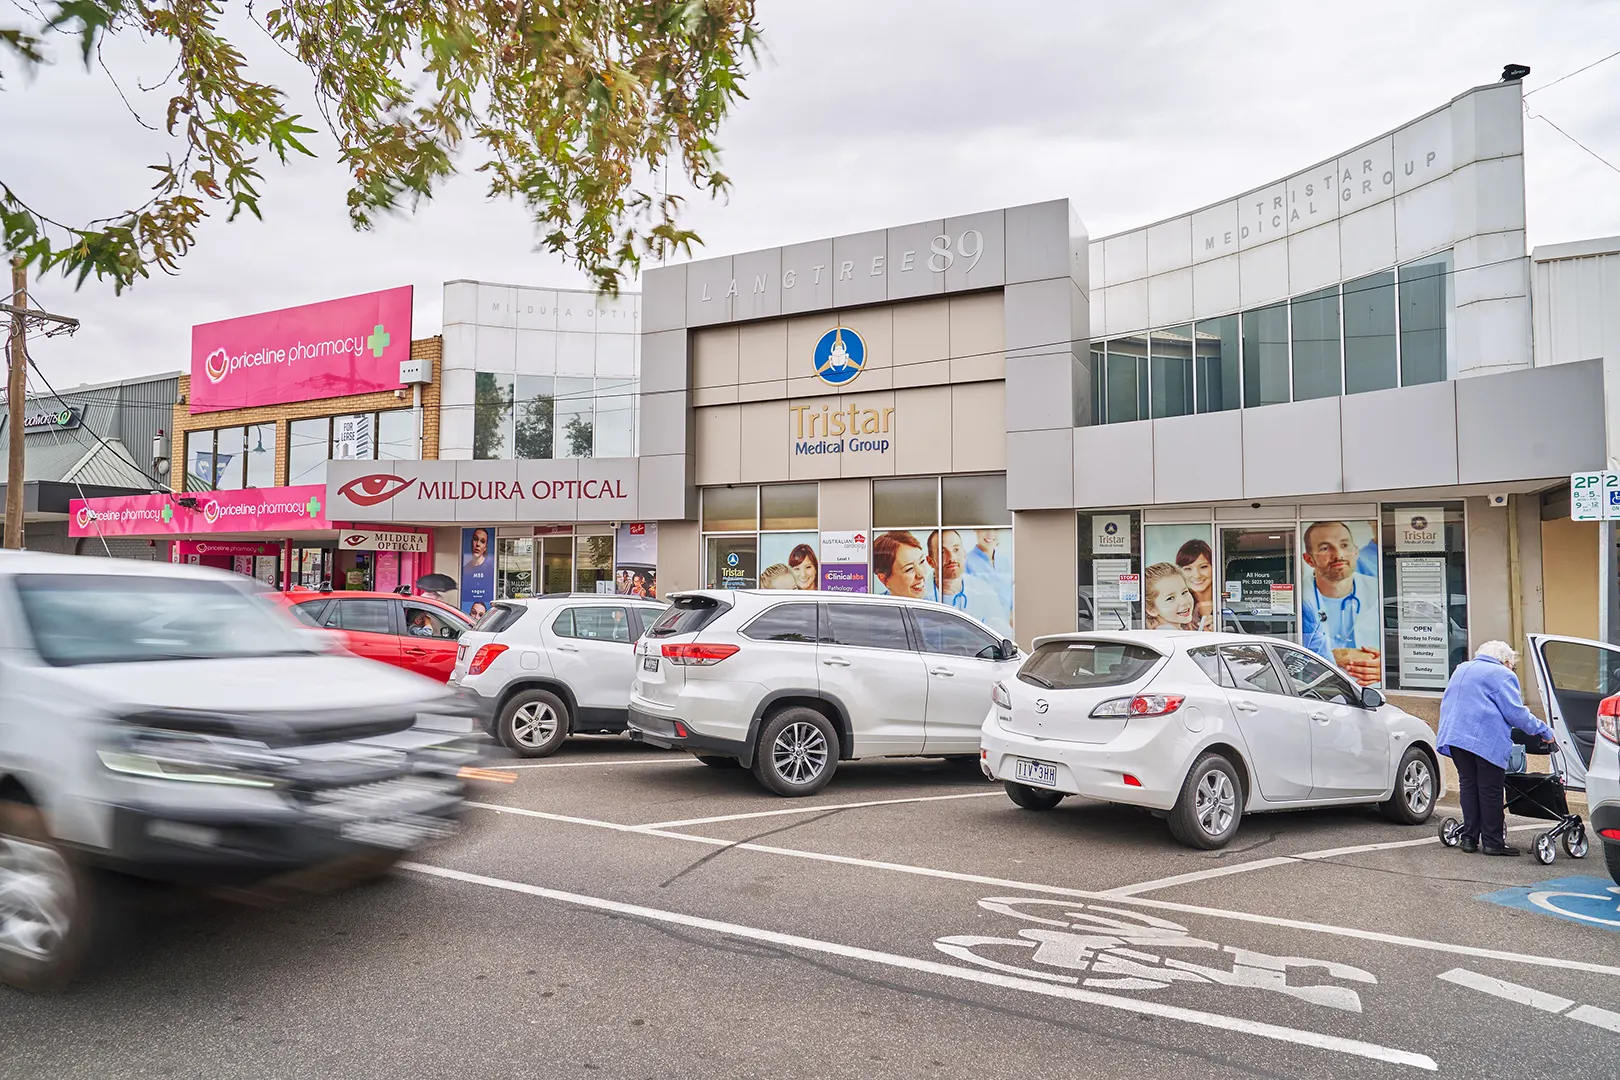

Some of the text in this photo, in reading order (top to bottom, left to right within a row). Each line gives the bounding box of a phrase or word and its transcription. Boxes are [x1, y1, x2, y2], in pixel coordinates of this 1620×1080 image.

[1255, 158, 1374, 215] TRISTAR
[1205, 151, 1437, 250] MEDICAL GROUP
[701, 229, 985, 303] LANGTREE 89
[492, 302, 572, 317] MILDURA
[230, 336, 364, 374] priceline pharmacy
[343, 422, 354, 432] FOR
[790, 402, 895, 439] Tristar
[340, 431, 355, 442] LEASE
[795, 438, 890, 456] Medical Group
[417, 479, 628, 500] MILDURA OPTICAL
[1574, 476, 1600, 489] 2P
[120, 508, 161, 524] pharmacy
[219, 501, 305, 519] priceline pharmacy
[374, 533, 424, 543] MILDURA
[1098, 535, 1125, 544] Tristar
[1403, 530, 1437, 540] Tristar
[230, 545, 257, 553] pharmacy
[377, 542, 421, 551] OPTICAL
[721, 567, 745, 577] Tristar
